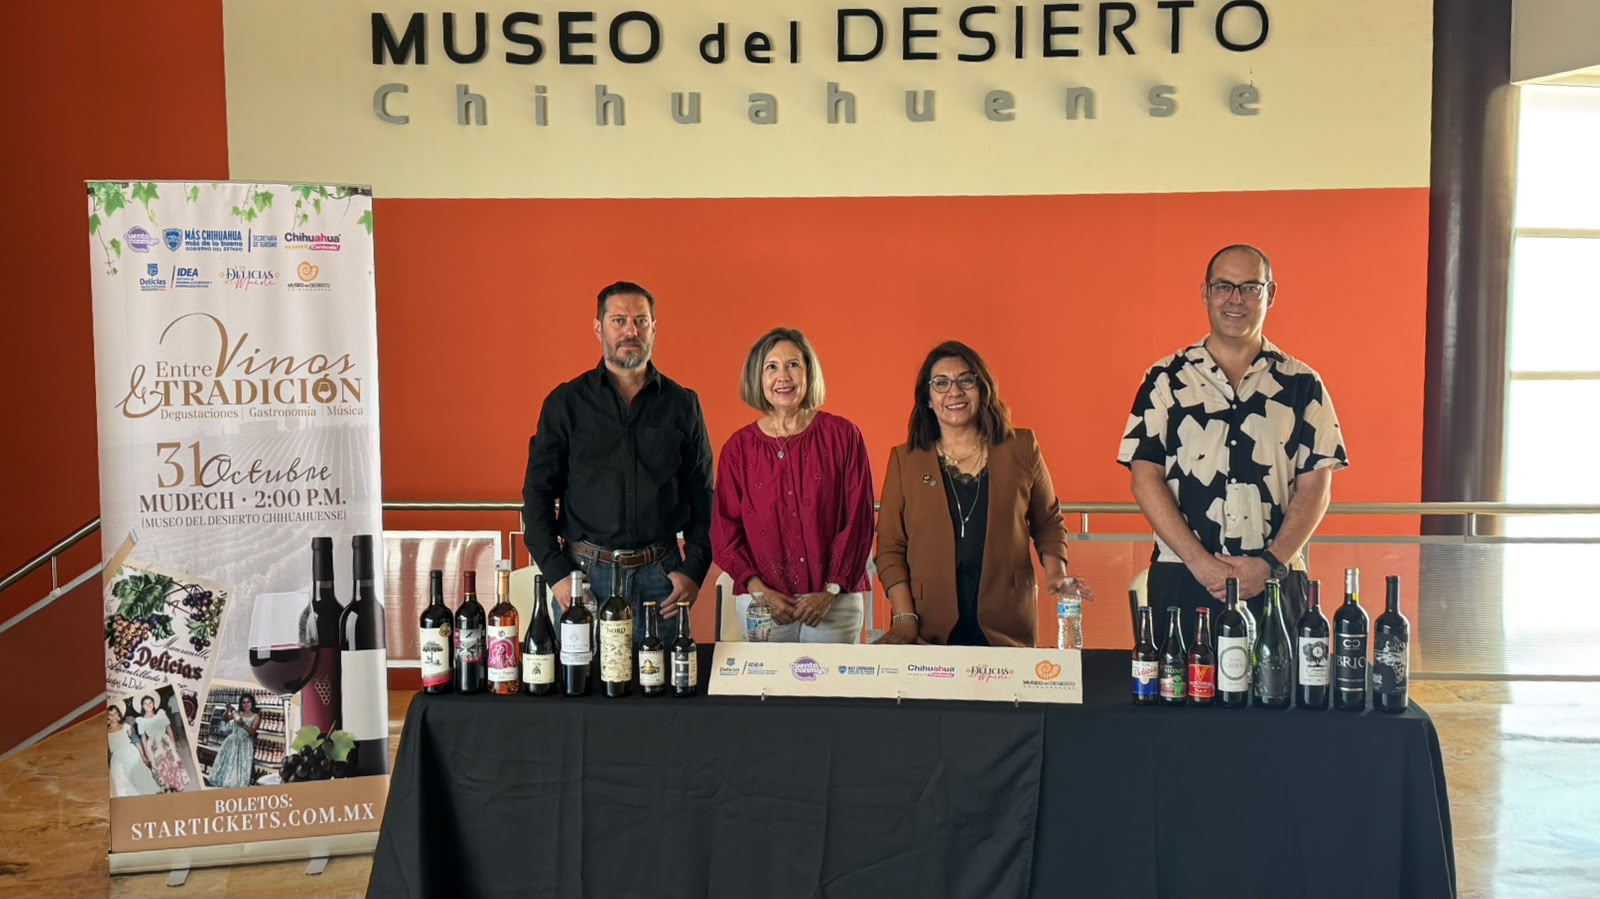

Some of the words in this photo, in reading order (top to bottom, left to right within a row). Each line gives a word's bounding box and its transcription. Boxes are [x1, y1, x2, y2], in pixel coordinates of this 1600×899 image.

[371, 11, 661, 65] MUSEO
[699, 20, 800, 64] del
[837, 0, 1269, 63] DESIERTO
[372, 81, 1262, 127] Chihuahuense
[184, 229, 200, 240] MÁS
[202, 230, 242, 241] CHIHUAHUA
[284, 232, 340, 243] Chihuahua
[140, 278, 167, 286] Delicias
[177, 268, 198, 277] IDEA
[226, 267, 274, 281] DELICIAS
[159, 312, 356, 378] Vinos
[156, 361, 213, 378] Entre
[155, 374, 363, 407] TRADICIÓN
[160, 408, 239, 422] Degustaciones
[249, 406, 317, 419] Gastronomía
[326, 405, 364, 416] Música
[156, 441, 201, 489] 31
[199, 454, 332, 489] Octubre
[139, 491, 235, 513] MUDECH
[254, 489, 301, 509] 2:00
[306, 487, 347, 506] P.M.
[141, 517, 183, 529] (MUSEO
[185, 516, 206, 527] DEL
[207, 514, 259, 526] DESIERTO
[261, 510, 347, 524] CHIHUAHUENSE)
[133, 646, 203, 681] Delicias
[907, 664, 955, 672] Chihuahua
[215, 794, 293, 814] BOLETOS:
[131, 803, 375, 841] STARTICKETS.COM.MX
